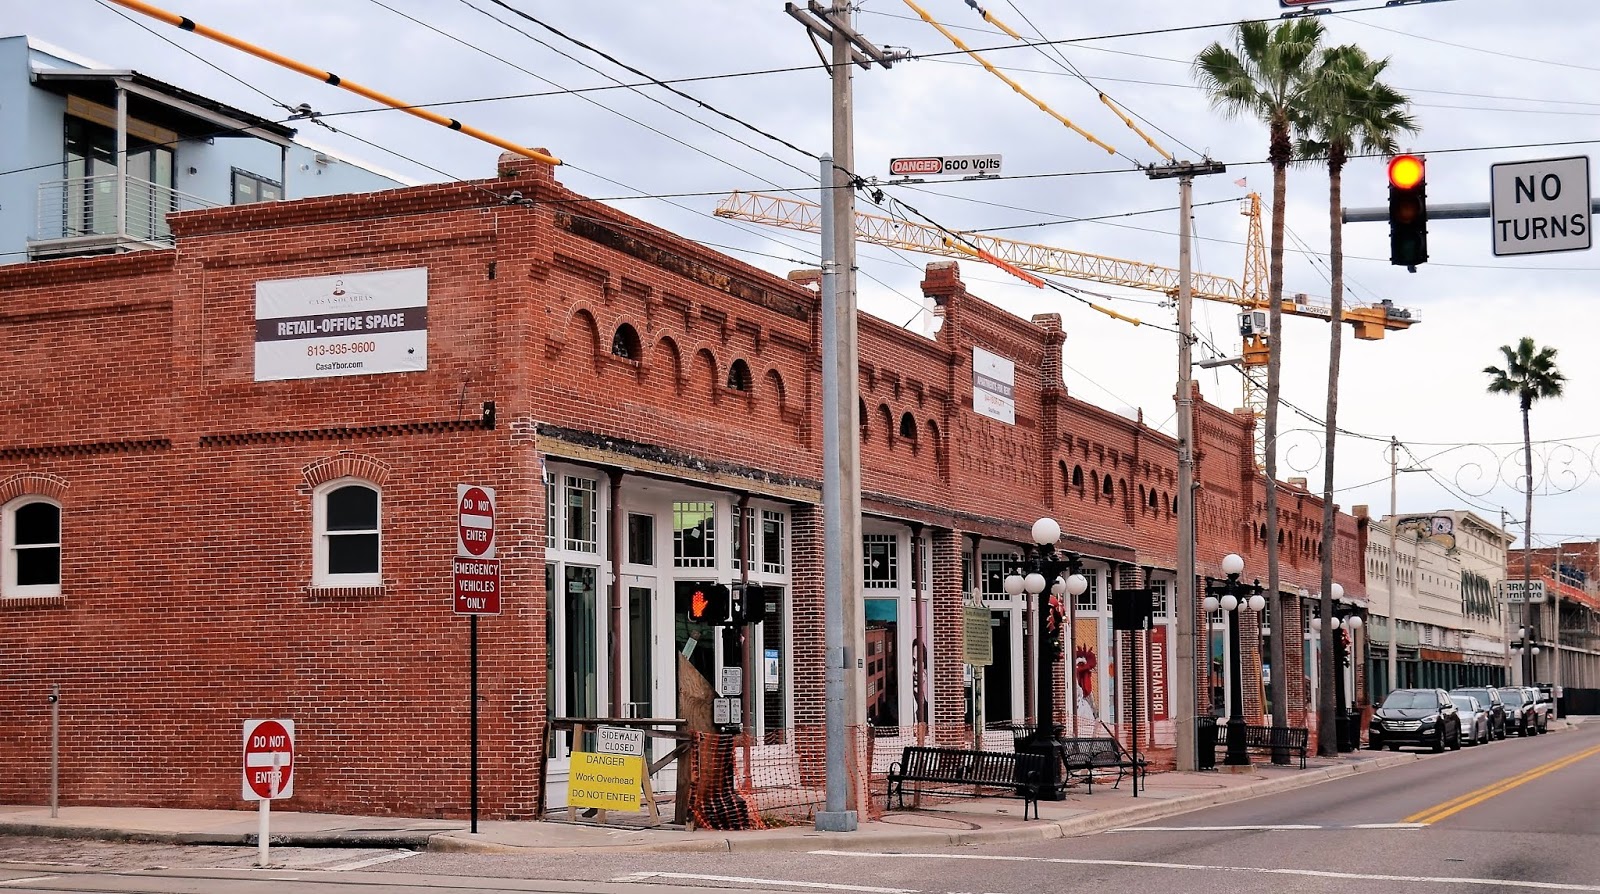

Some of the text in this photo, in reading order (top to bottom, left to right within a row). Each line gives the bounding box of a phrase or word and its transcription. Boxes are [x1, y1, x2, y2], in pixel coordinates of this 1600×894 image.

[894, 158, 1000, 172] DANGER 600 Volts
[1515, 173, 1561, 203] NO
[1497, 213, 1585, 241] TURNS
[1305, 306, 1329, 315] MORROW
[277, 313, 405, 336] RETAIL-OFFICE SPACE
[307, 341, 376, 357] 813-935-9600
[315, 361, 364, 371] CasaYbor.com
[463, 498, 490, 512] DO NOT
[466, 529, 487, 542] ENTER
[454, 562, 499, 576] EMERGENCY
[458, 579, 495, 593] VEHICLES
[466, 597, 487, 609] ONLY
[253, 735, 286, 748] DO NOT
[601, 731, 640, 742] SIDEWALK
[604, 742, 635, 752] CLOSED
[586, 755, 625, 766] DANGER
[575, 772, 634, 785] Work Overhead
[572, 789, 636, 802] DO NOT ENTER
